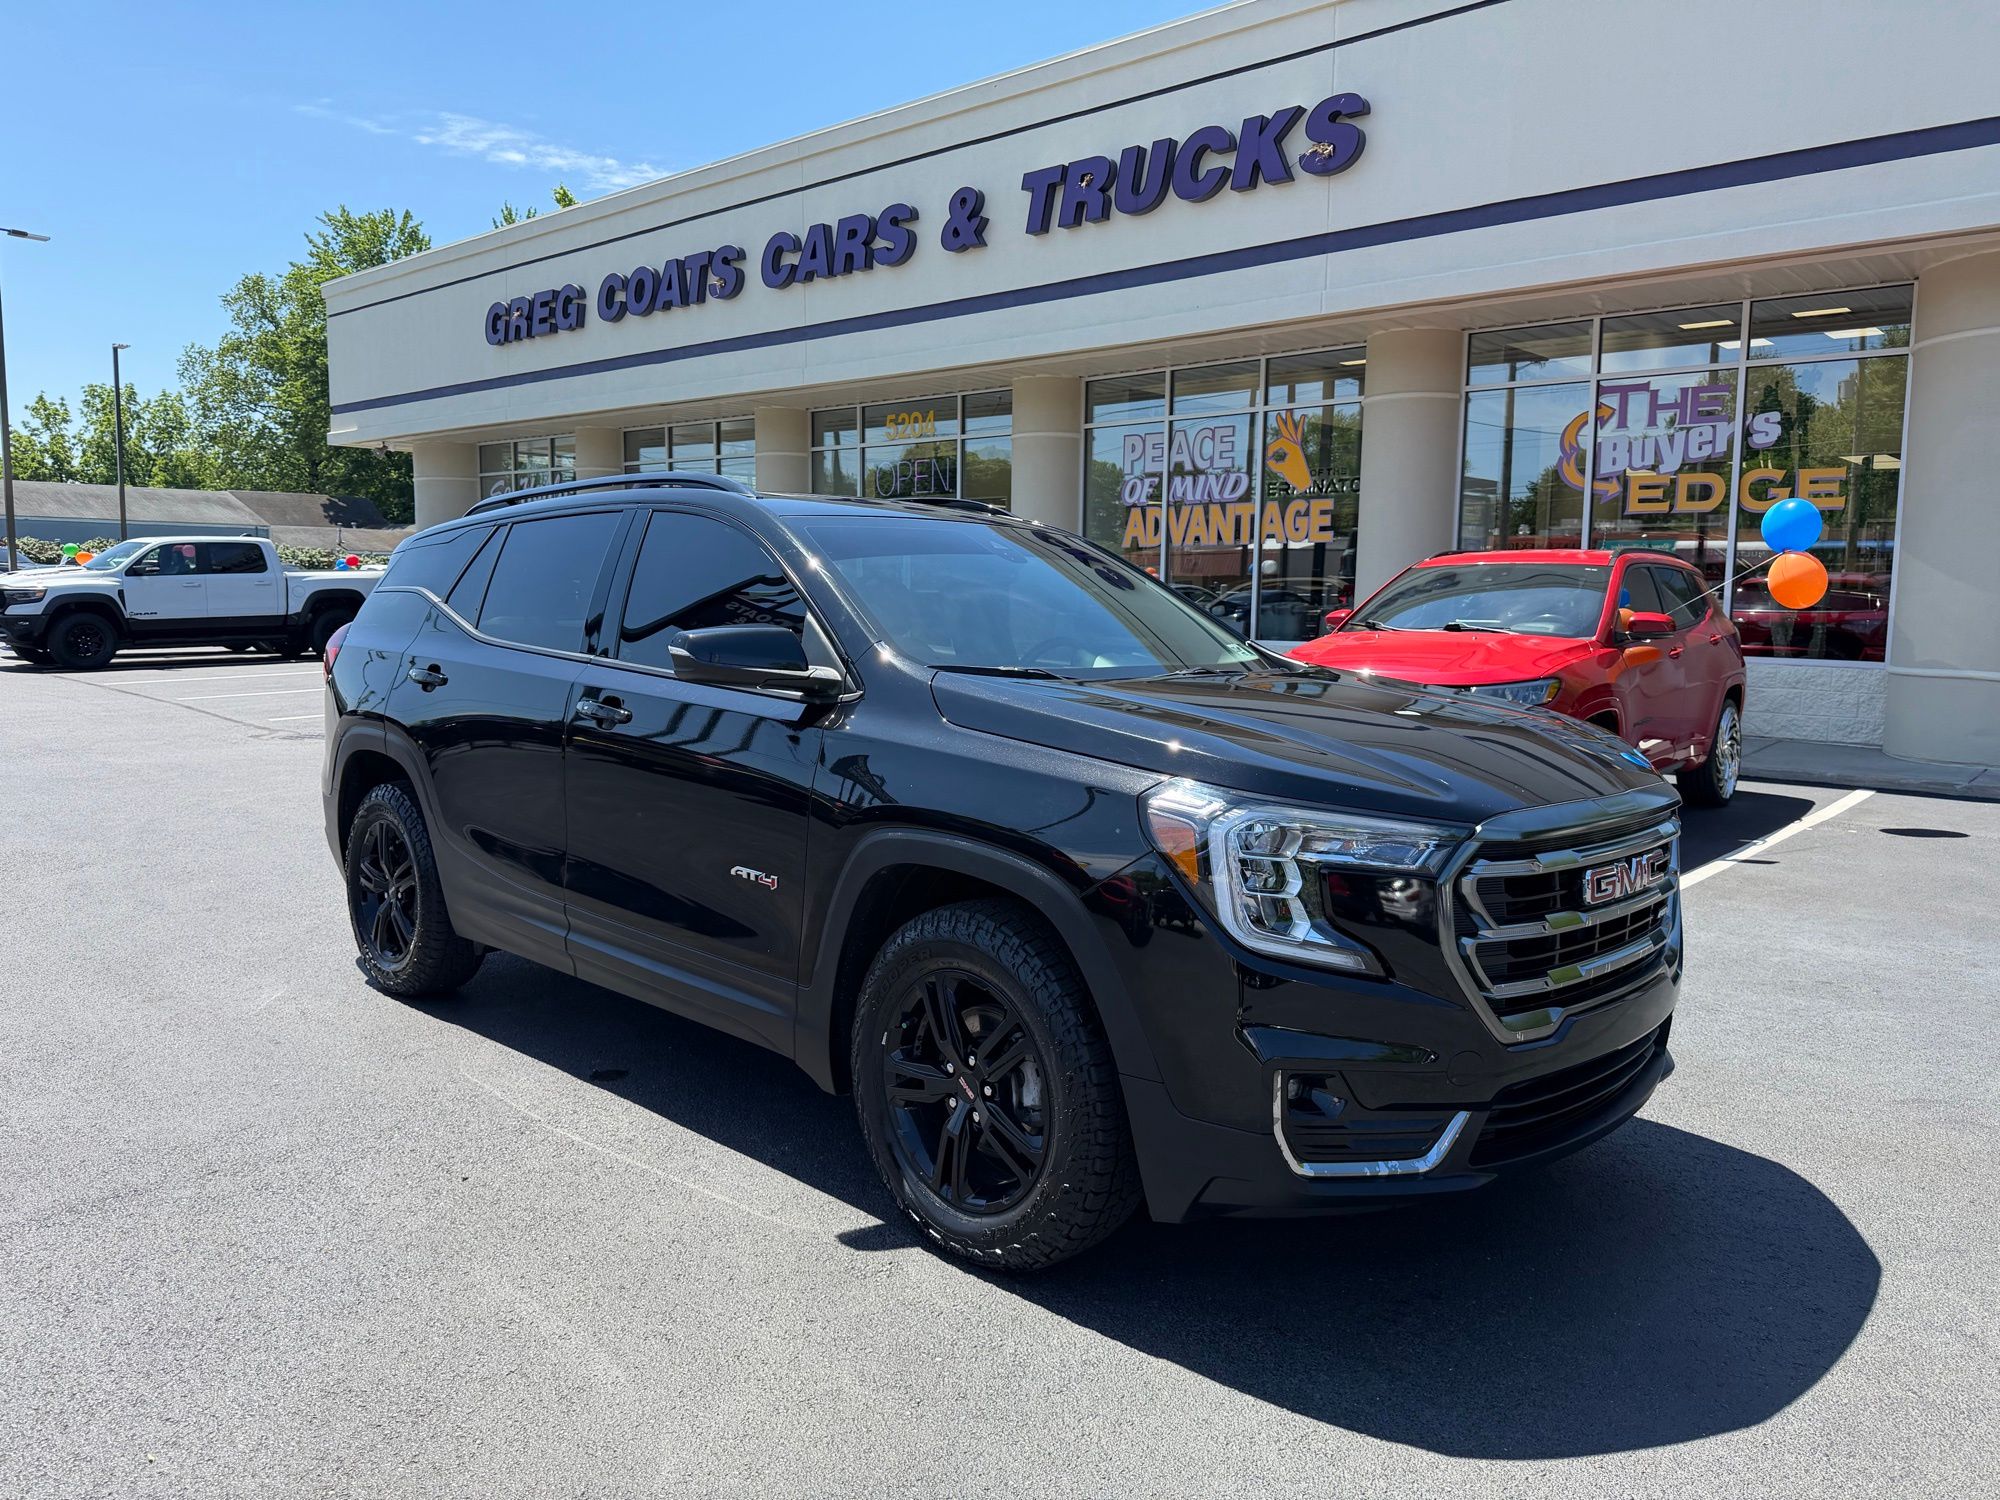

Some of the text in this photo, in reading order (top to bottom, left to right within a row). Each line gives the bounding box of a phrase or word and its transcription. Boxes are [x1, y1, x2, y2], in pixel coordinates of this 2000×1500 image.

[485, 92, 1371, 346] GREG COATS CARS & TRUCKS
[884, 410, 936, 440] 5204
[1599, 381, 1731, 431] THE
[1123, 425, 1236, 476] PEACE
[876, 458, 950, 496] OPEN
[1121, 472, 1249, 506] OF MIND
[1624, 467, 1847, 515] EDGE
[1121, 498, 1335, 548] ADVANTAGE
[730, 865, 778, 890] AT4
[1583, 848, 1664, 905] GMC
